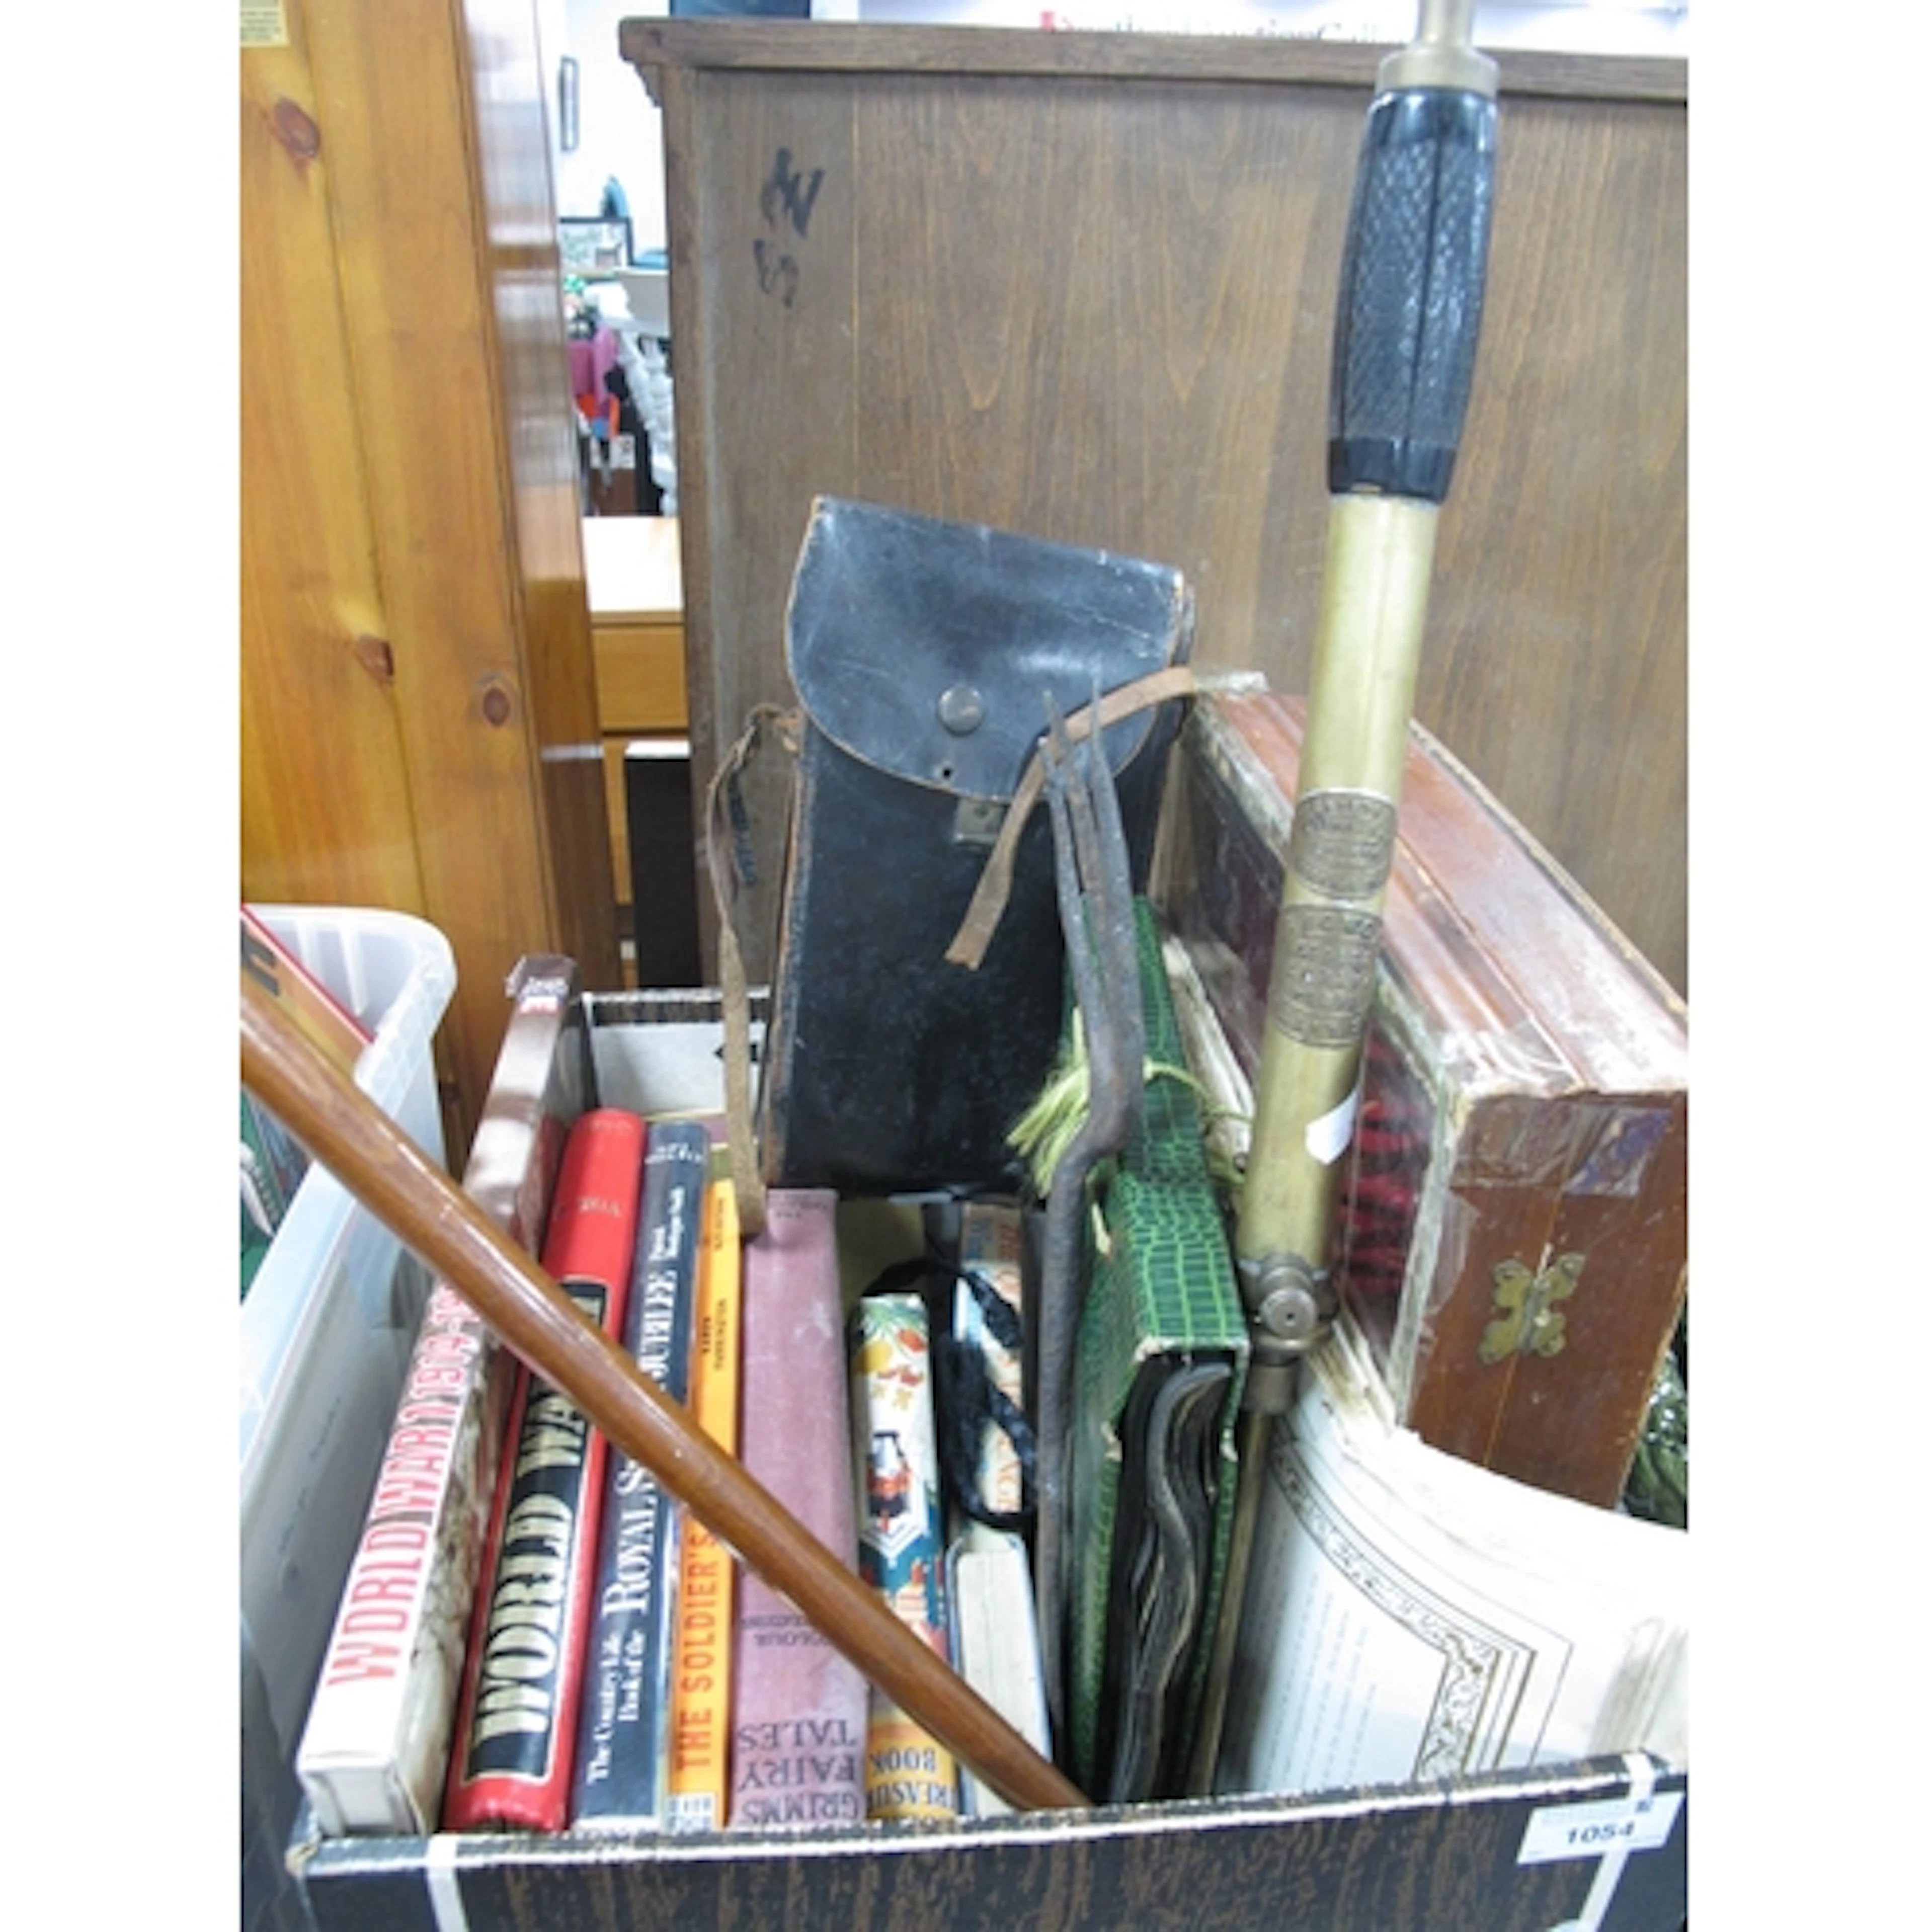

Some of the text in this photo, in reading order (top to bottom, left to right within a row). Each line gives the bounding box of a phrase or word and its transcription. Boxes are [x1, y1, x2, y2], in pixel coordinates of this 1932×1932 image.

[373, 1426, 452, 1519] WAR
[517, 1385, 586, 1478] WA
[602, 1494, 658, 1619] ROYAL
[328, 1522, 430, 1687] WORLD
[475, 1495, 573, 1743] WORLD
[682, 1532, 718, 1694] SOLDIER'S
[586, 1744, 611, 1785] The
[676, 1708, 712, 1772] THE
[736, 1718, 858, 1753] TALES
[737, 1755, 856, 1793] FAIRY
[1567, 1819, 1635, 1845] 1054
